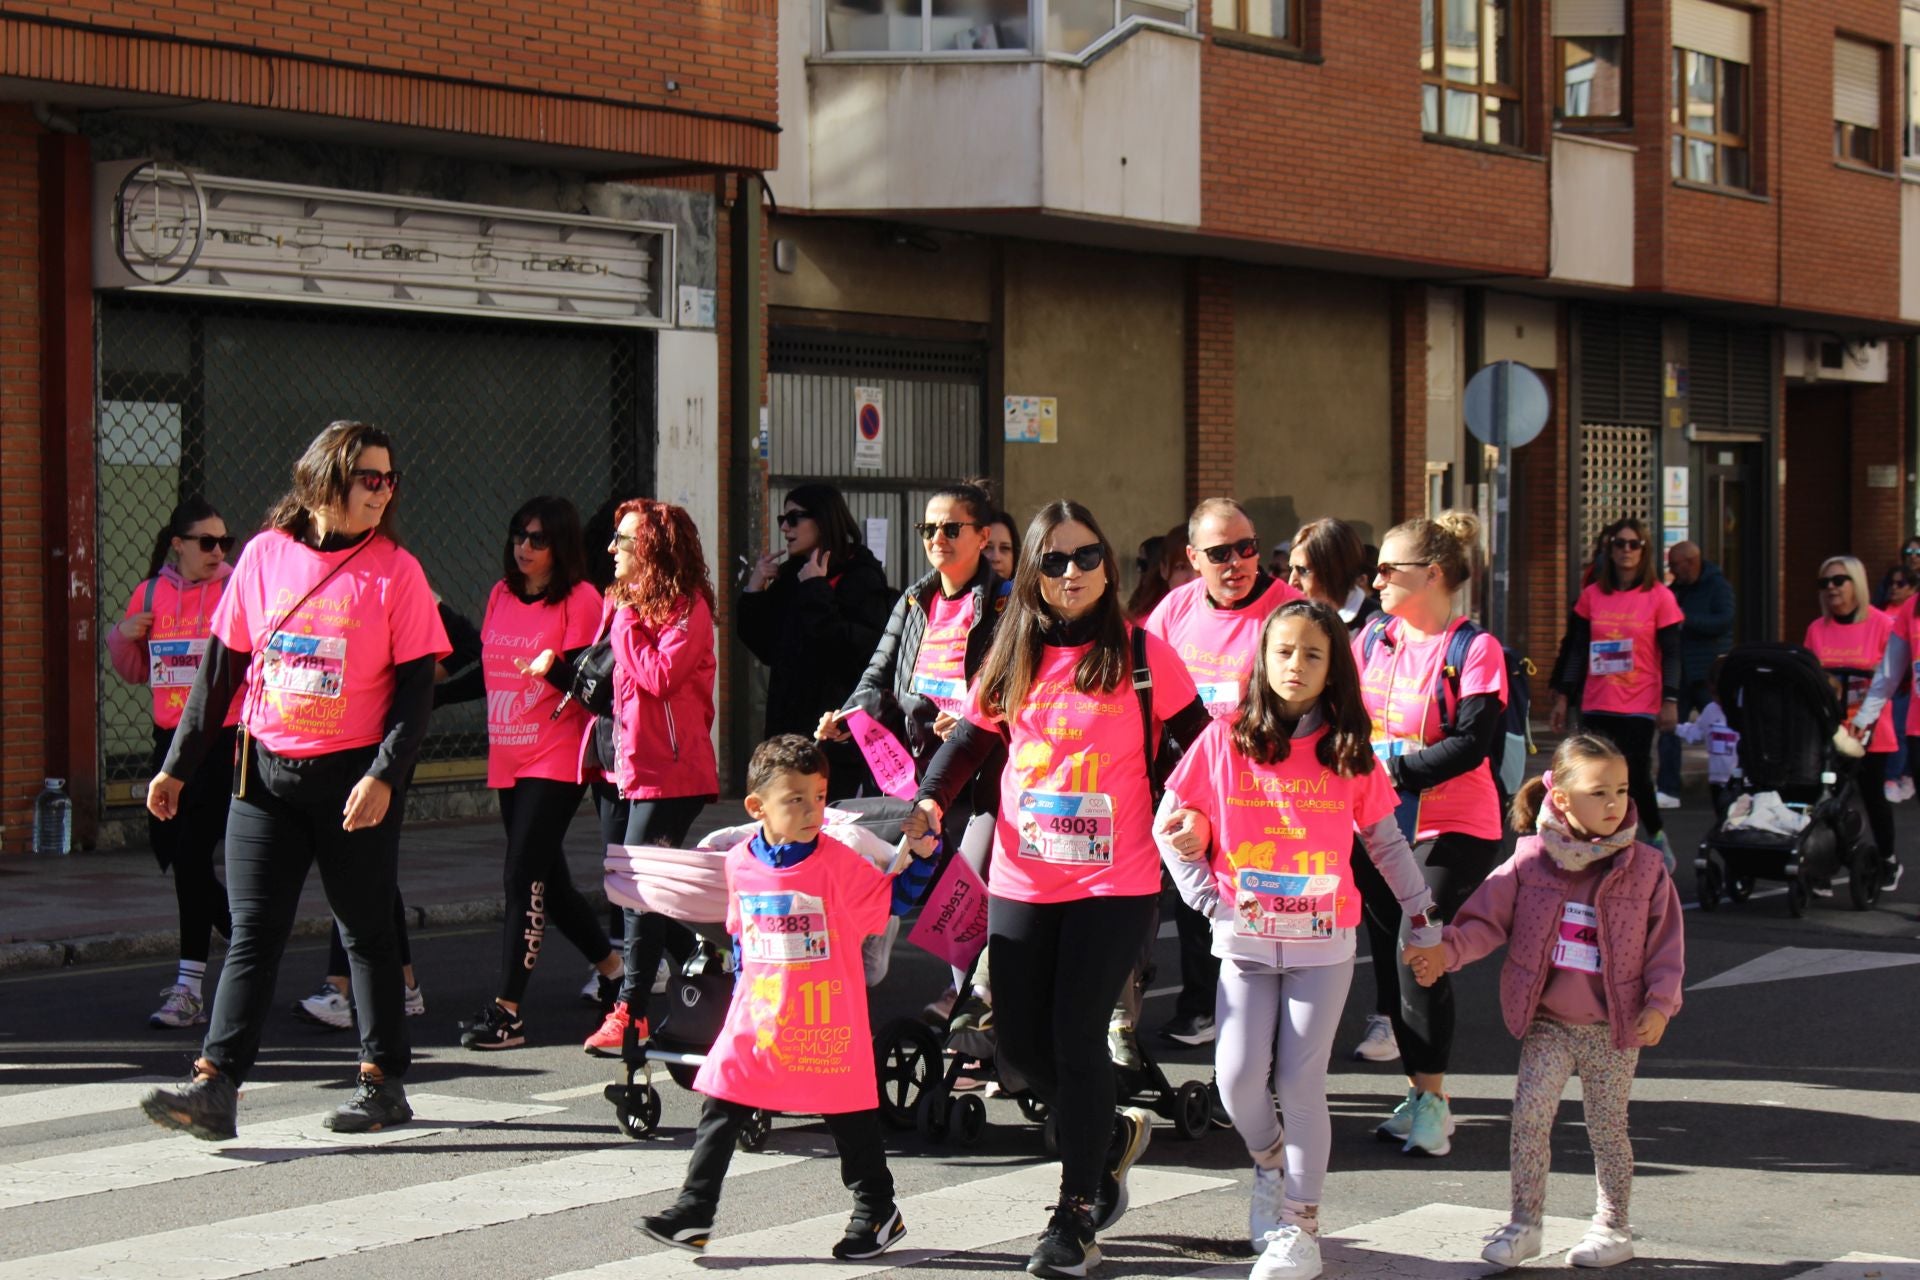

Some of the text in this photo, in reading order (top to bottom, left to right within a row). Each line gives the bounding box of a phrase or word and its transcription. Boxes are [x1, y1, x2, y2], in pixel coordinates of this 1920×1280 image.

[581, 679, 598, 705] FILA
[1074, 702, 1124, 714] CAROBELS
[505, 723, 539, 735] MUJER
[1043, 726, 1083, 738] SUZUKI
[1295, 799, 1345, 810] CAROBELS
[1050, 817, 1098, 834] 4903
[1263, 826, 1307, 836] SUZUKI
[1273, 896, 1318, 913] 3281
[523, 880, 545, 970] adidas
[766, 915, 811, 933] 3283
[781, 1026, 851, 1043] Carrera
[800, 1040, 851, 1059] Mujer
[788, 1064, 851, 1074] DRASANVI
